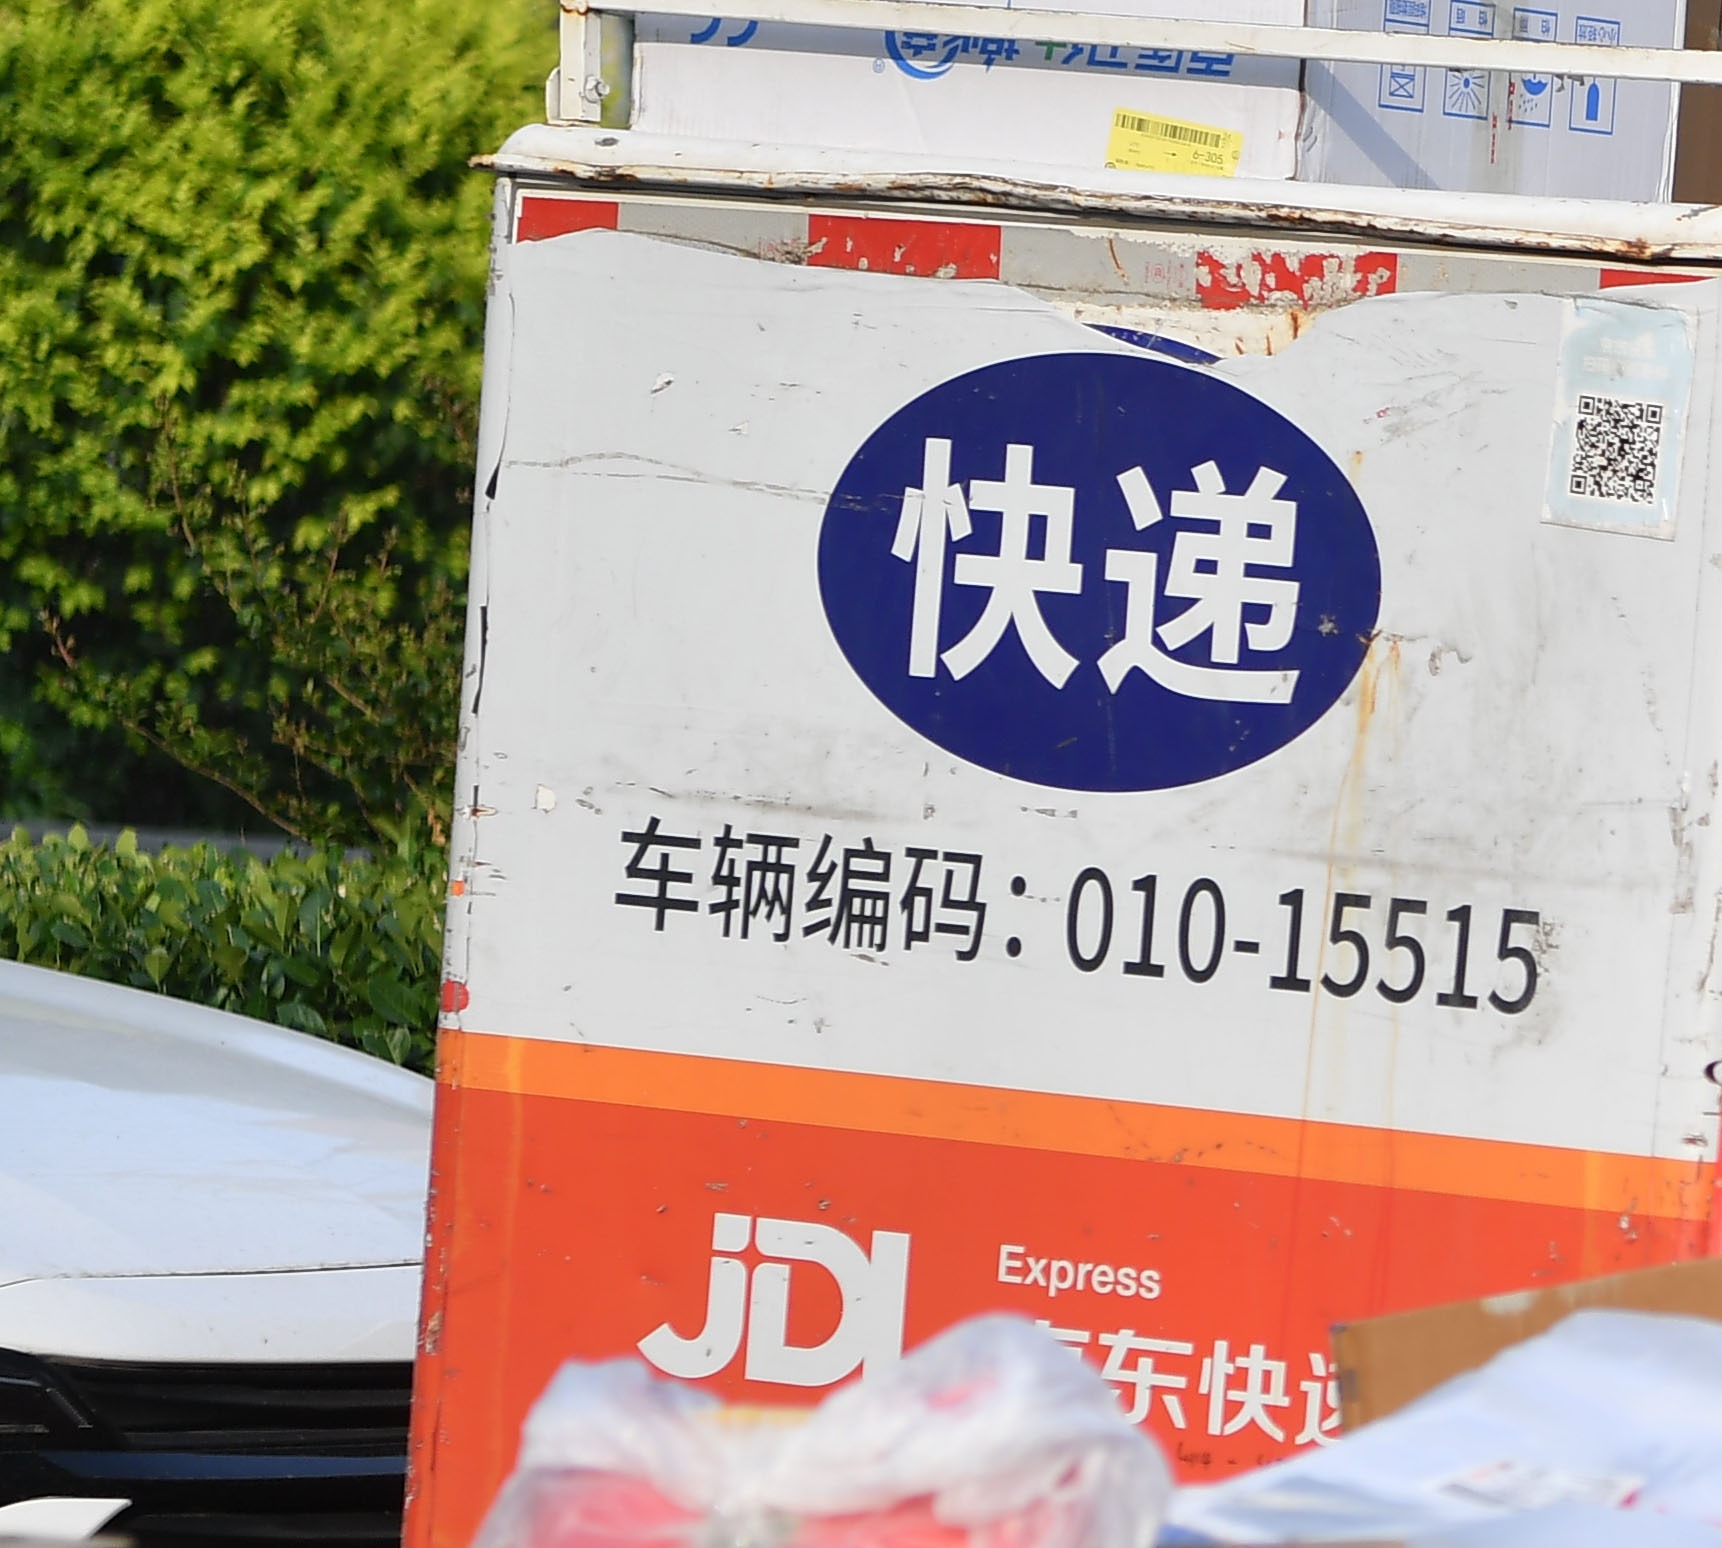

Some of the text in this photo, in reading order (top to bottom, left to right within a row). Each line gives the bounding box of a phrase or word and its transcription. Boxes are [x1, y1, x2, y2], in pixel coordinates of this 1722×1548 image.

[892, 437, 1301, 704] 快递
[997, 1243, 1162, 1302] Express
[1034, 1316, 1343, 1449] 东快
